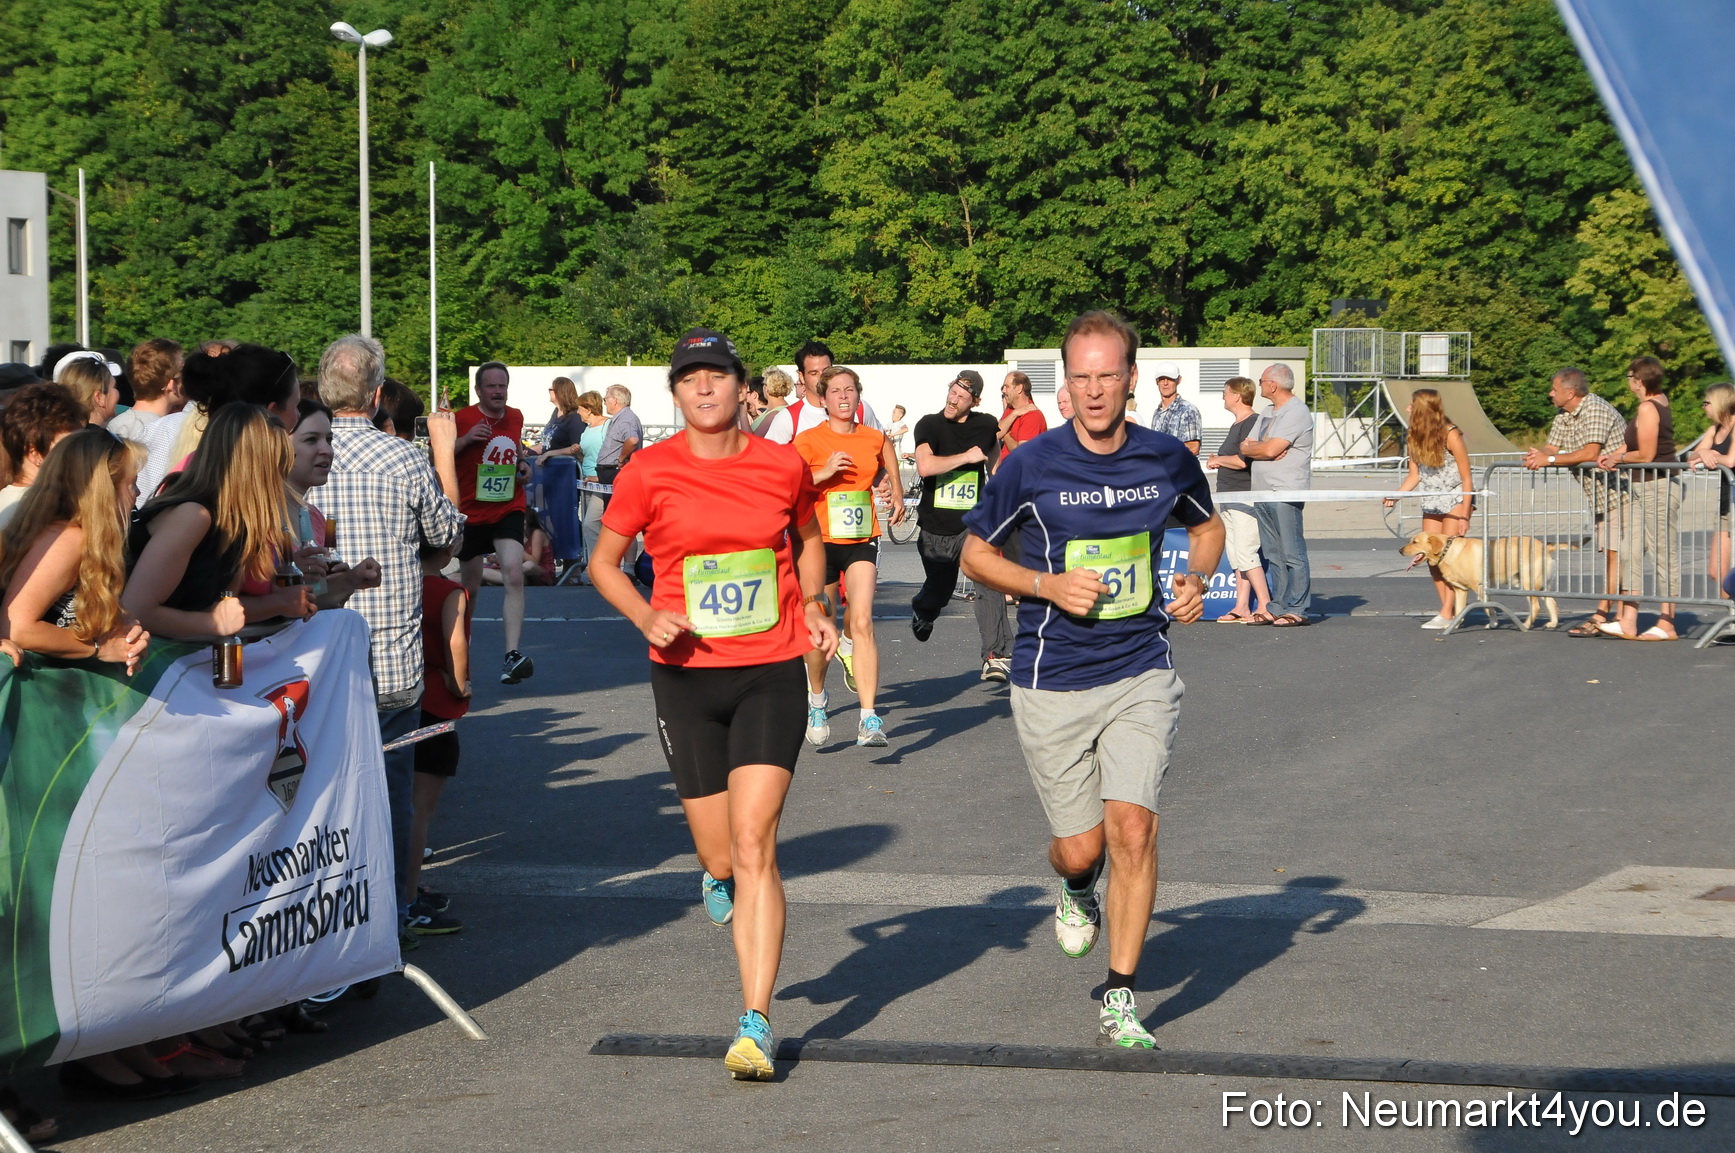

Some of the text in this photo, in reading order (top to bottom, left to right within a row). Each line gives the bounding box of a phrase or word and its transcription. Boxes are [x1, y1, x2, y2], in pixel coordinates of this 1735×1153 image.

[487, 446, 515, 465] 48
[482, 477, 511, 492] 457
[938, 483, 976, 500] 1145
[1060, 485, 1160, 506] EURO POLES
[842, 507, 864, 526] 39
[1087, 563, 1136, 599] 61
[699, 578, 763, 616] 497
[243, 824, 350, 897] Neumarkter
[222, 868, 370, 974] Lammsbräu
